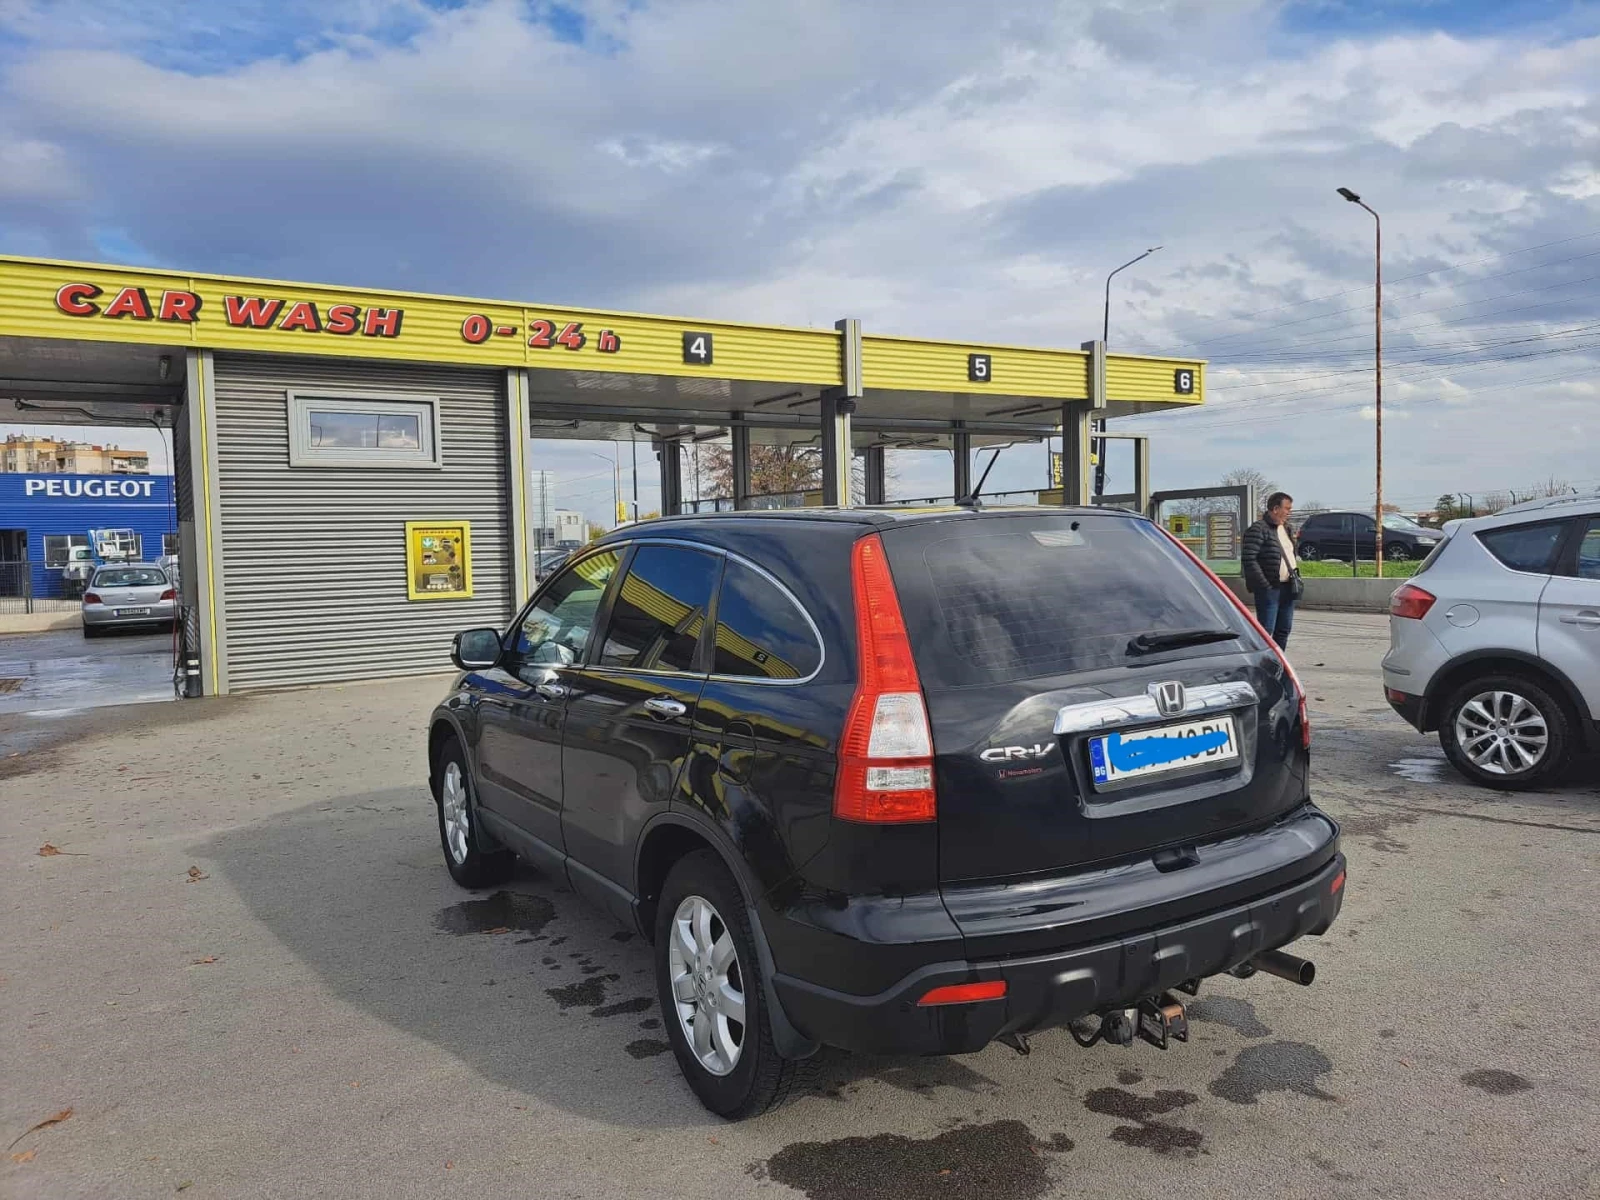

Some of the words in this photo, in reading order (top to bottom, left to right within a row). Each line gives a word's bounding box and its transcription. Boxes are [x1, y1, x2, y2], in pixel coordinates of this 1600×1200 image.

[55, 283, 203, 322] CAR
[224, 295, 404, 338] WASH
[598, 330, 620, 353] h
[690, 337, 707, 358] 4
[975, 358, 987, 377] 5
[1180, 373, 1190, 389] 6
[25, 479, 156, 497] PEUGEOT
[980, 742, 1056, 762] CR-V
[1094, 766, 1106, 777] BG
